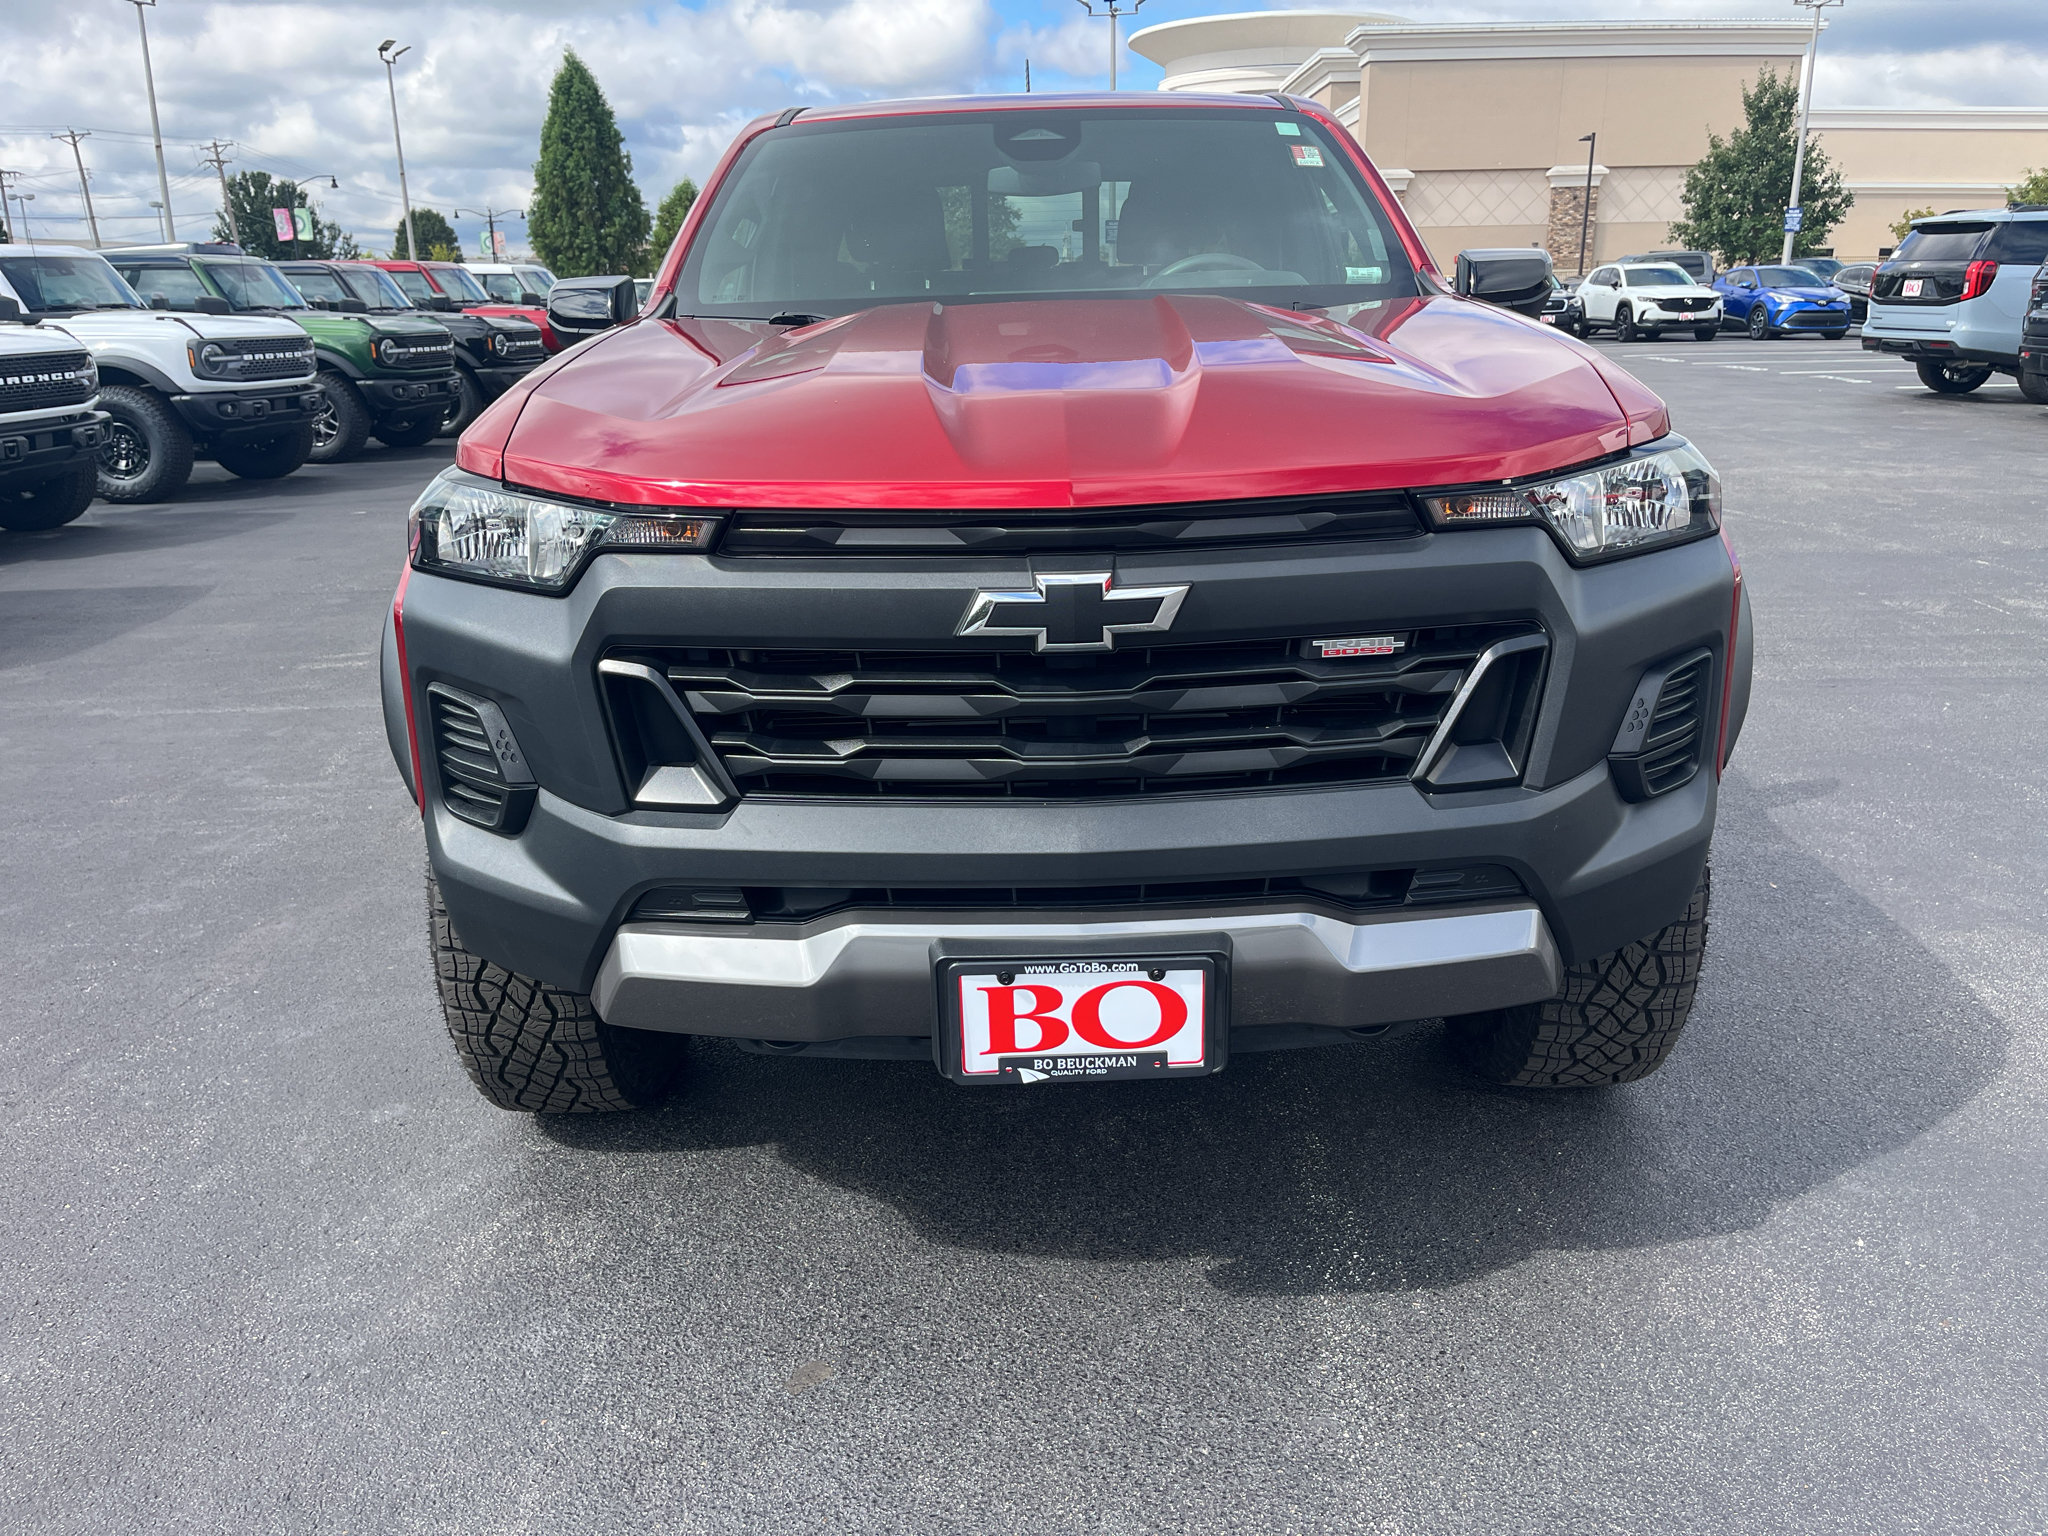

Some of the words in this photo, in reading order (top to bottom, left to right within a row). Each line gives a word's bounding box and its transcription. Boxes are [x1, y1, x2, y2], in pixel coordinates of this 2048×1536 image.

[1905, 283, 1920, 293] BO
[409, 345, 448, 353] BRONCO
[242, 351, 302, 360] BRONCO
[1312, 636, 1405, 649] TRAIL
[1322, 646, 1394, 657] BOSS
[1024, 962, 1139, 974] www.GoToBo.com
[976, 979, 1189, 1056] BO
[1033, 1059, 1053, 1070] BO
[1057, 1056, 1137, 1069] BEUCKMAN
